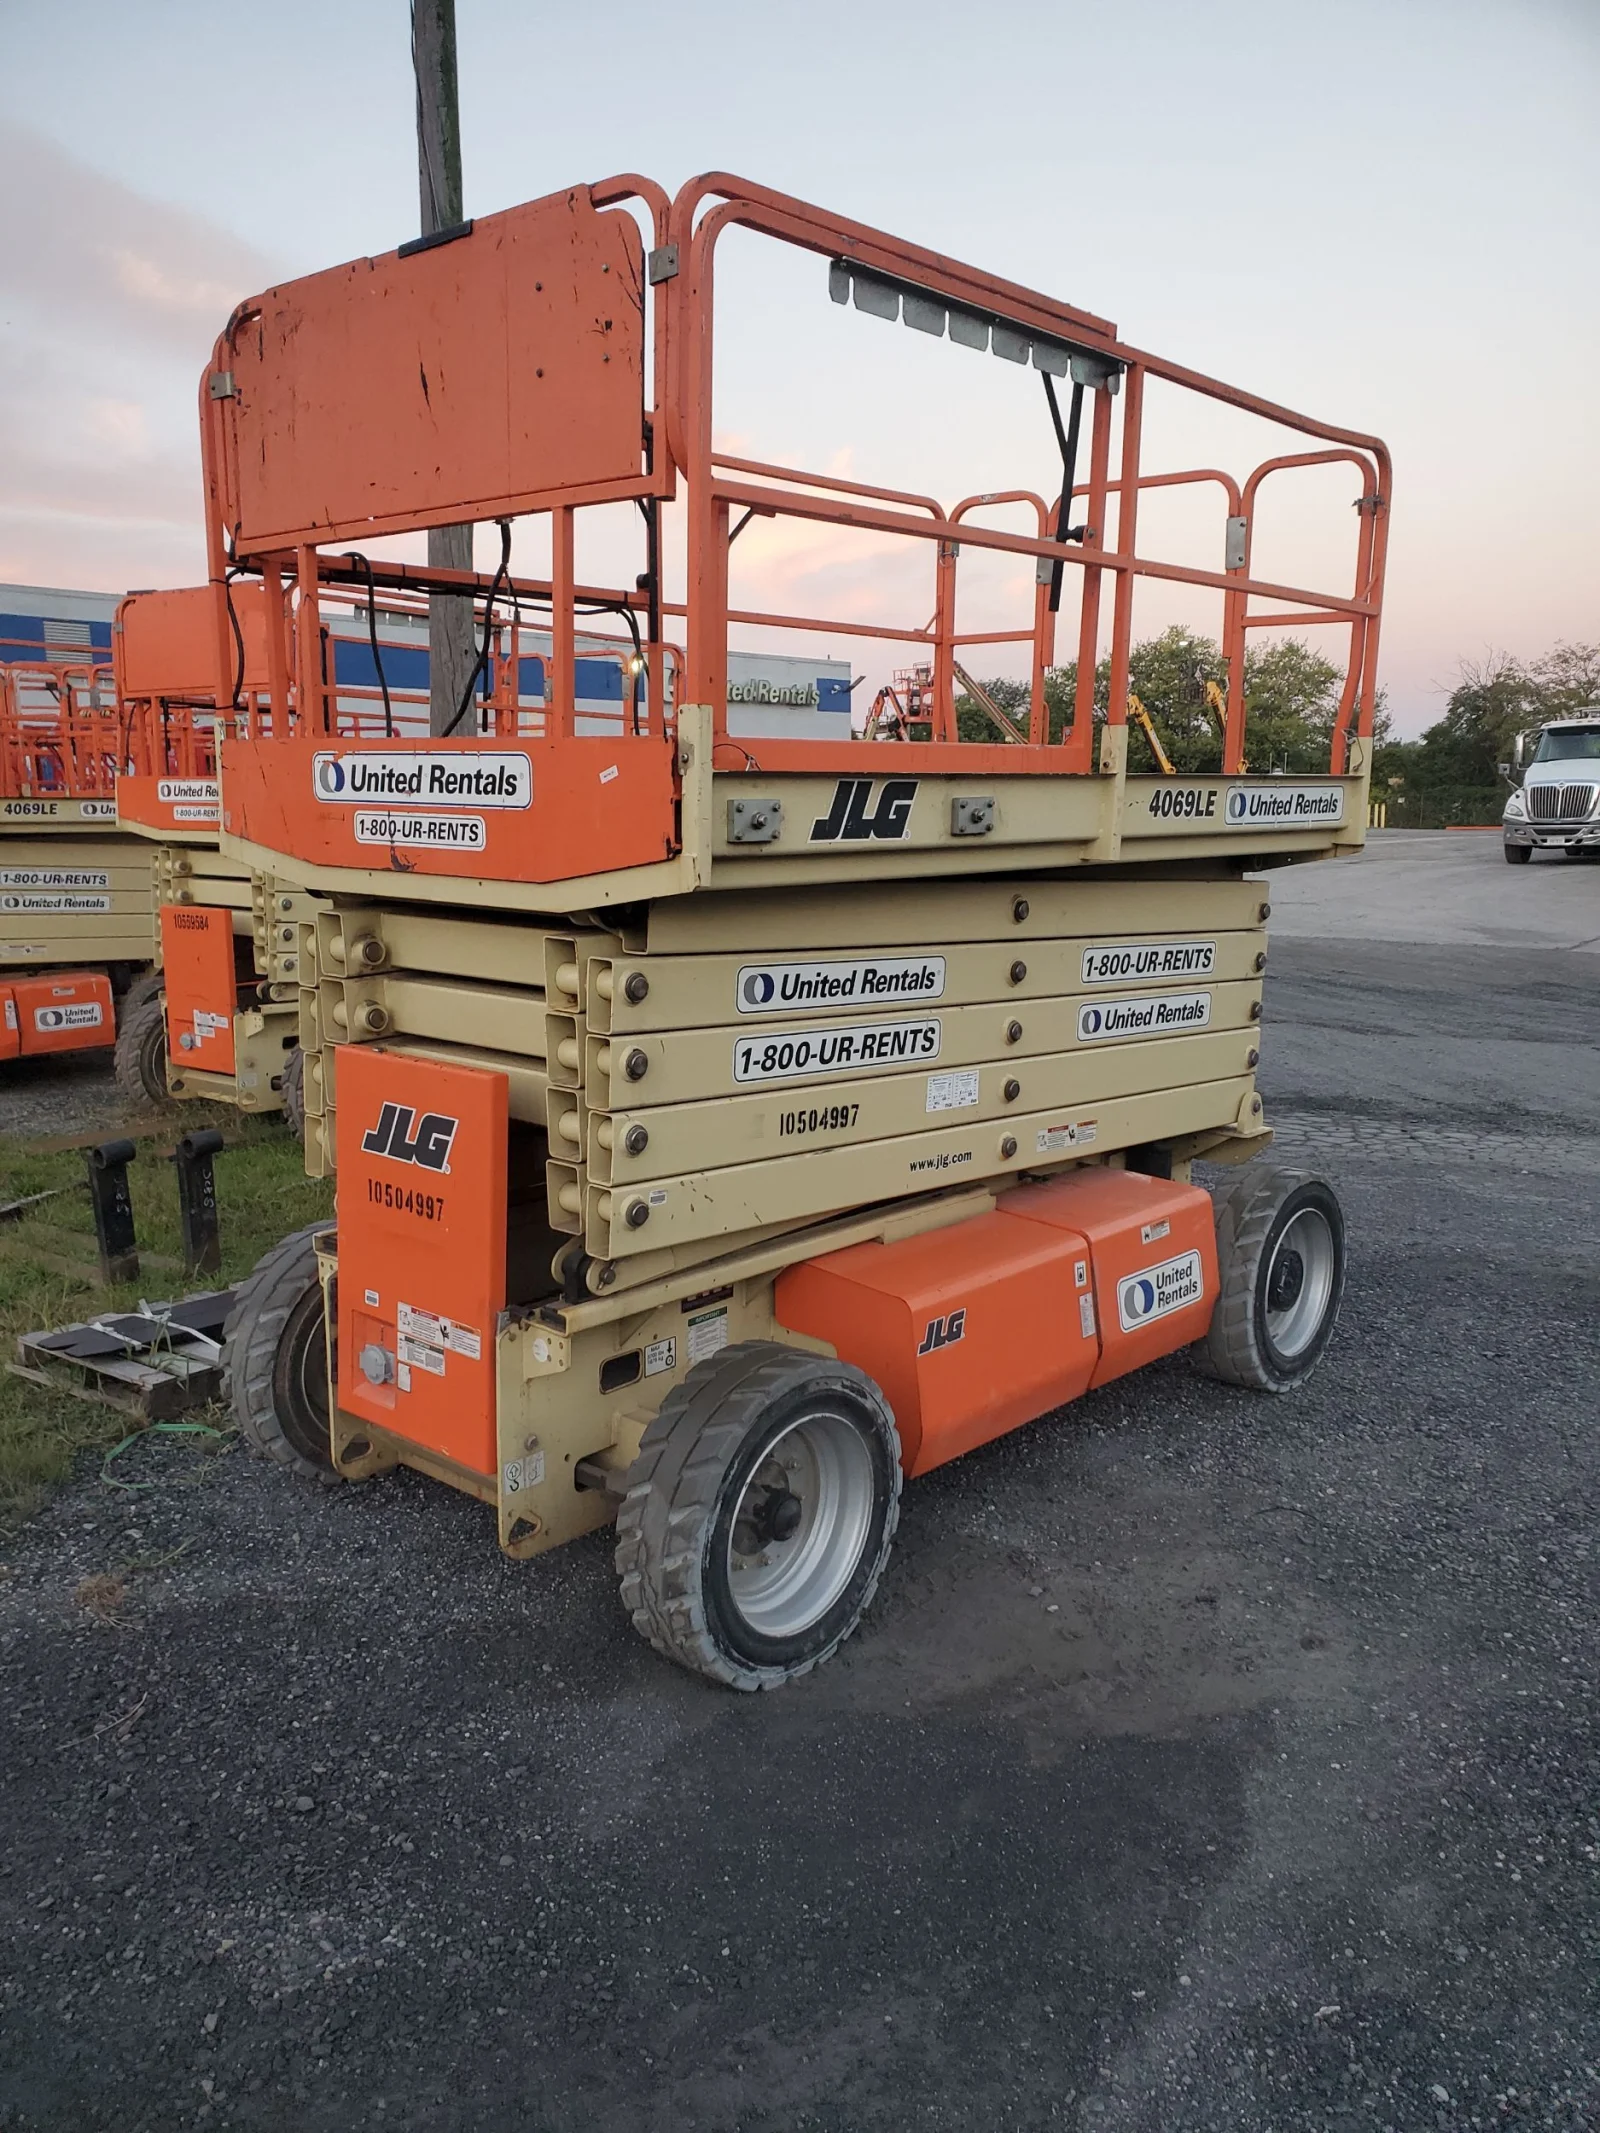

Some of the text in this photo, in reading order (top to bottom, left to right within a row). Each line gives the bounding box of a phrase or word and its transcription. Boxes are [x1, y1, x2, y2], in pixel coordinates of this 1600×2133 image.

[759, 679, 820, 704] Rentals
[173, 785, 219, 797] United Re
[350, 764, 518, 796] United Rentals
[4, 803, 58, 815] 4069LE
[808, 780, 919, 841] JLG
[1149, 789, 1217, 817] 4069LE
[1249, 793, 1338, 817] United Rentals
[359, 819, 479, 842] 1-800-UR-RENTS
[3, 873, 107, 885] 1-800-UR-RENTS
[22, 897, 105, 908] United Rentals
[1086, 947, 1213, 977] 1-800-UR-RENTS
[780, 965, 936, 1001] United Rentals
[65, 1006, 98, 1025] United Rentals
[1104, 999, 1205, 1031] United Rentals
[741, 1026, 936, 1075] 1-800-UR-RENTS
[779, 1104, 859, 1137] 10504997
[362, 1102, 458, 1171] JLG
[909, 1151, 972, 1173] www.jlg.com
[368, 1179, 444, 1222] 10504997
[1156, 1260, 1193, 1290] United
[1157, 1278, 1198, 1309] Rentals
[918, 1309, 965, 1356] JLG
